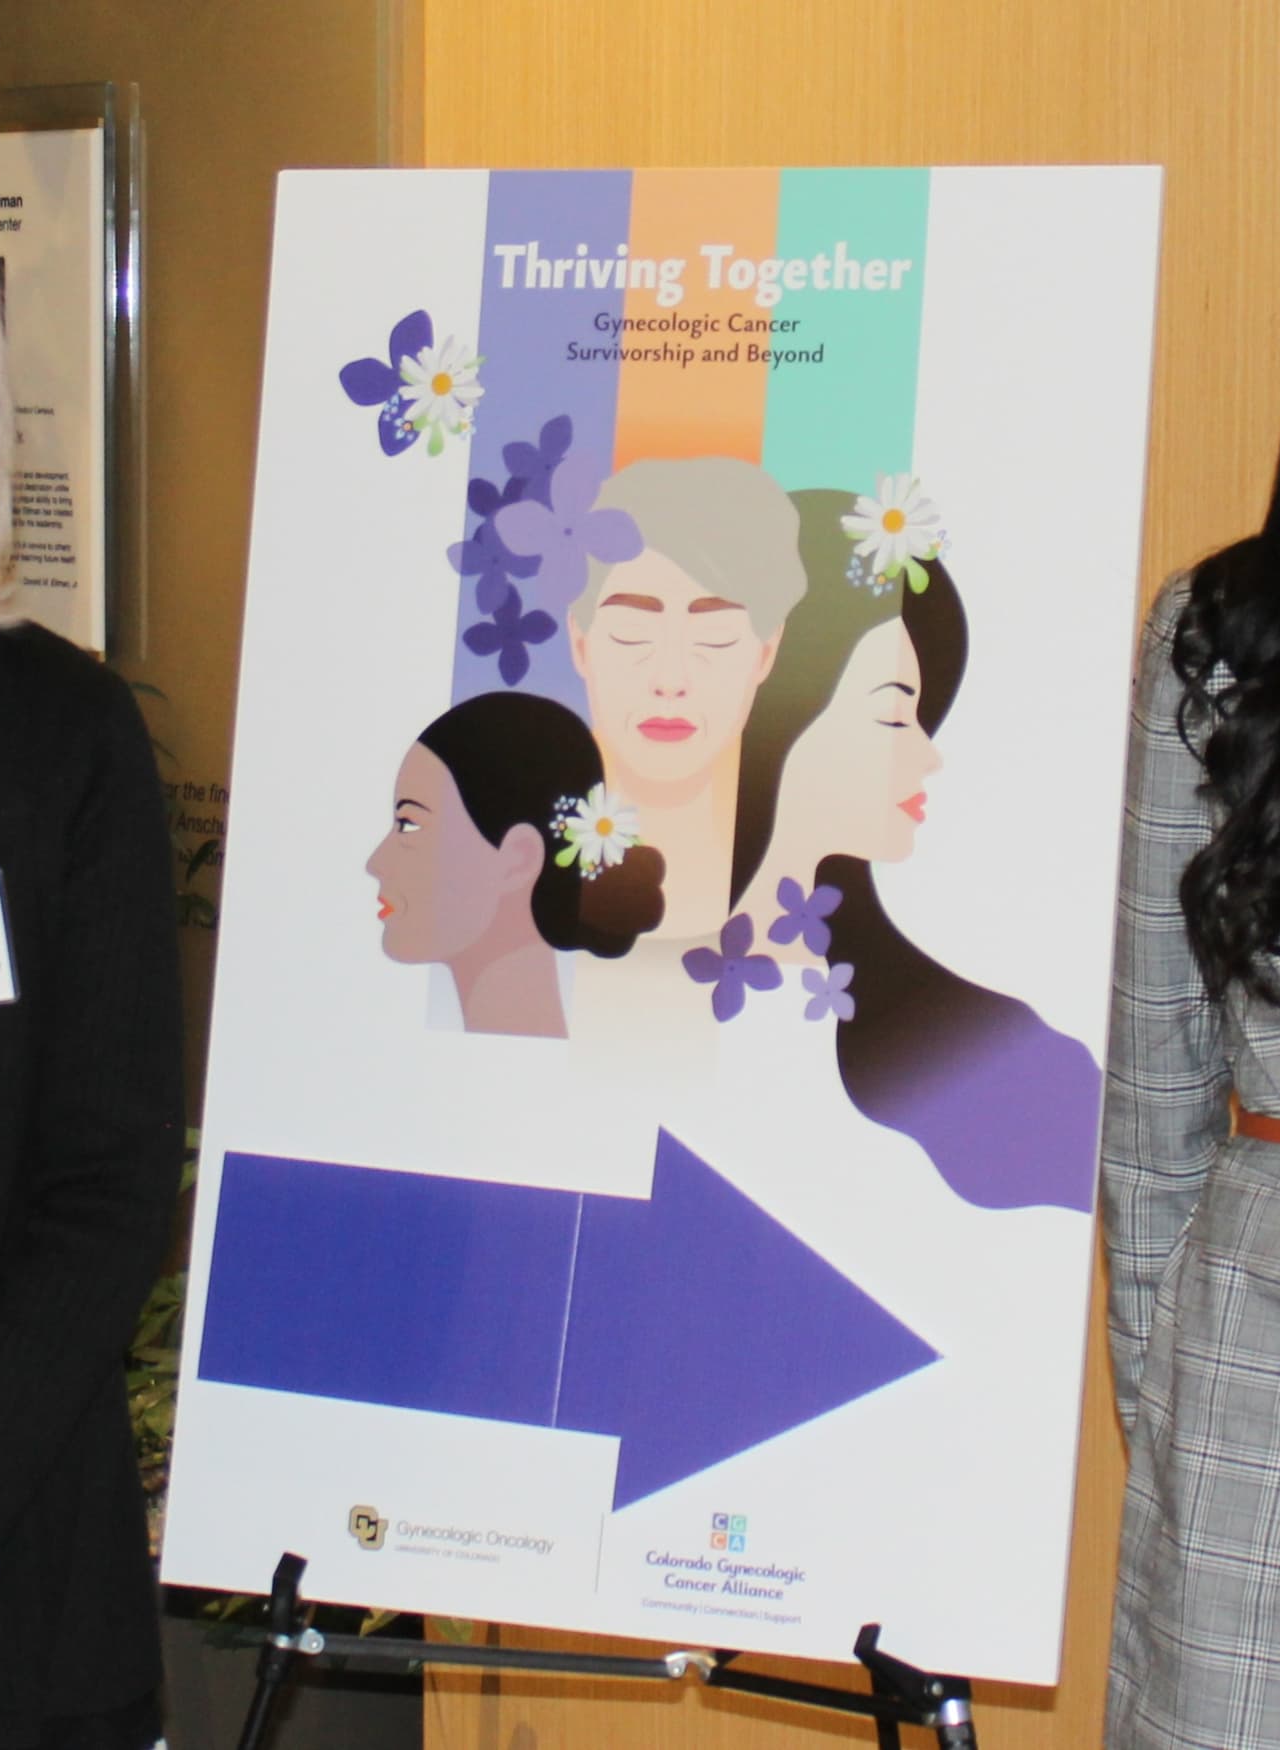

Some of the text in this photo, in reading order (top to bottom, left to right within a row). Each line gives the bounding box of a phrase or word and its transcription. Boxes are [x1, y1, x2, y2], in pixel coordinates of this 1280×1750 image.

[494, 241, 912, 308] Thriving Together
[594, 312, 800, 339] Gynecologic Cancer
[567, 342, 824, 369] Survivorship and Beyond
[183, 782, 205, 801] the
[210, 784, 228, 803] fin
[396, 1520, 555, 1555] Gynecologic Oncology
[646, 1550, 806, 1584] Colorado Gynecologic
[664, 1573, 784, 1600] Cancer Alliance
